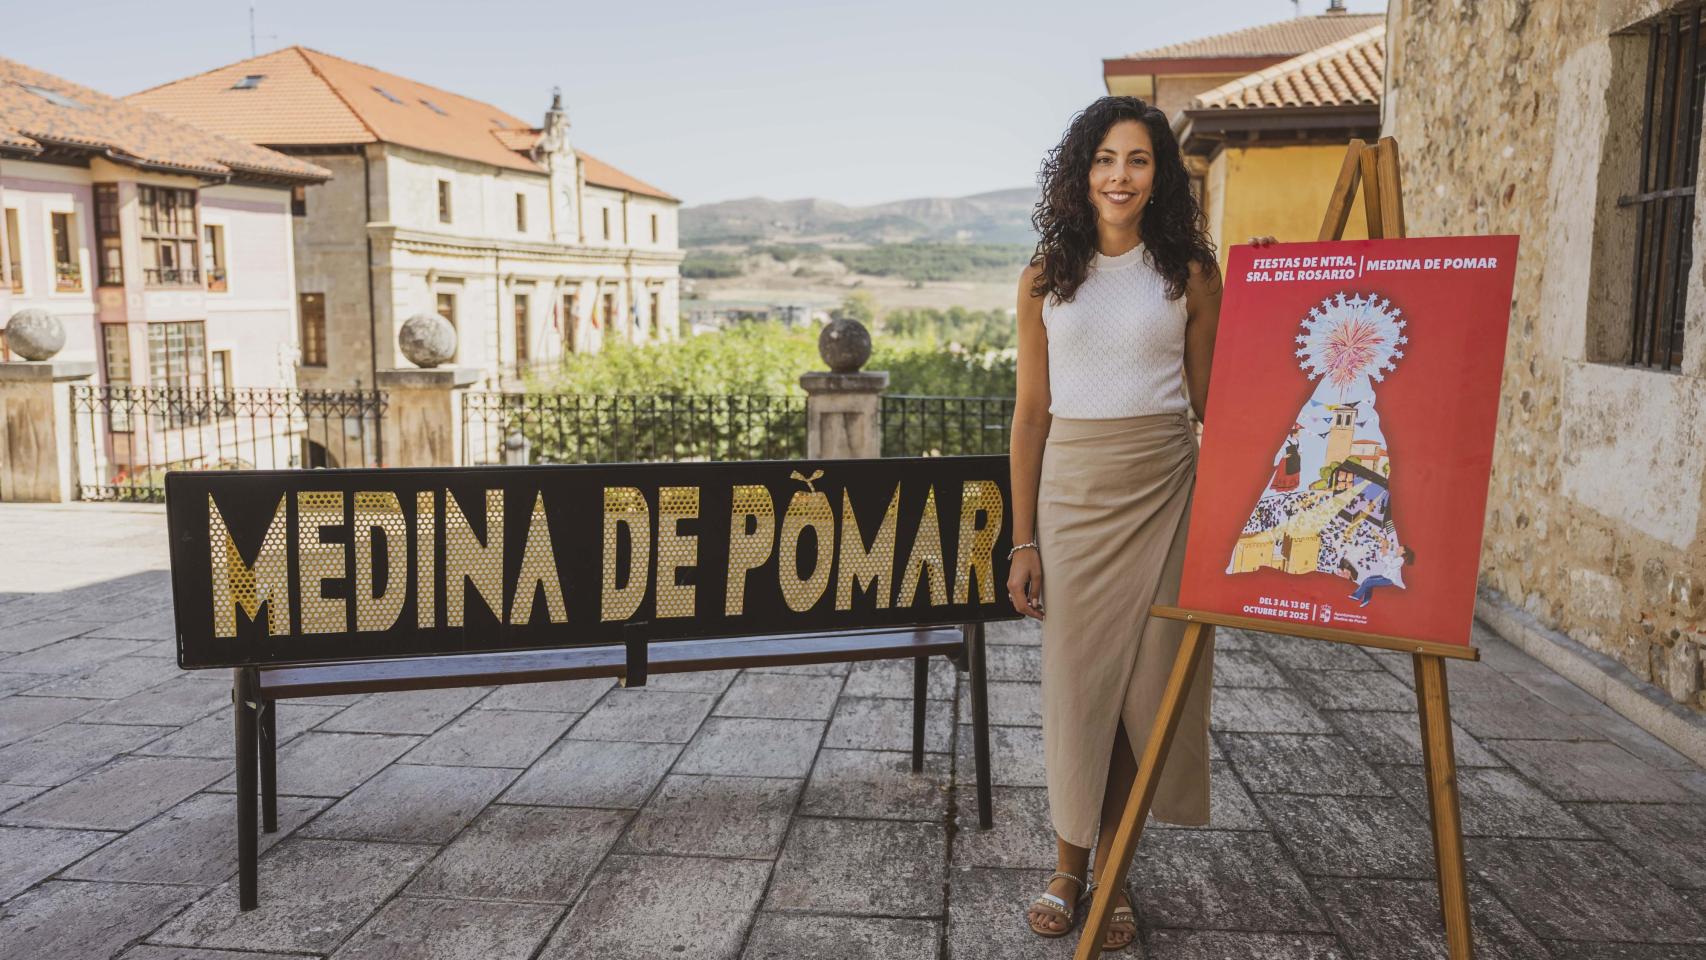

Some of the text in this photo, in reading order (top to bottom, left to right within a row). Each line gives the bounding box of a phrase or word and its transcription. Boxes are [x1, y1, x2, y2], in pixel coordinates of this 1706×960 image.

[1253, 256, 1357, 269] FIESTAS DE NTRA.
[1366, 257, 1498, 271] MEDINA DE POMAR
[1246, 269, 1355, 282] SRA. DEL ROSARIO
[208, 469, 1004, 638] MEDINA DE POMAR
[1259, 597, 1310, 610] DEL 3 AL 13 DE
[1243, 605, 1309, 620] OCTUBRE DE 2025
